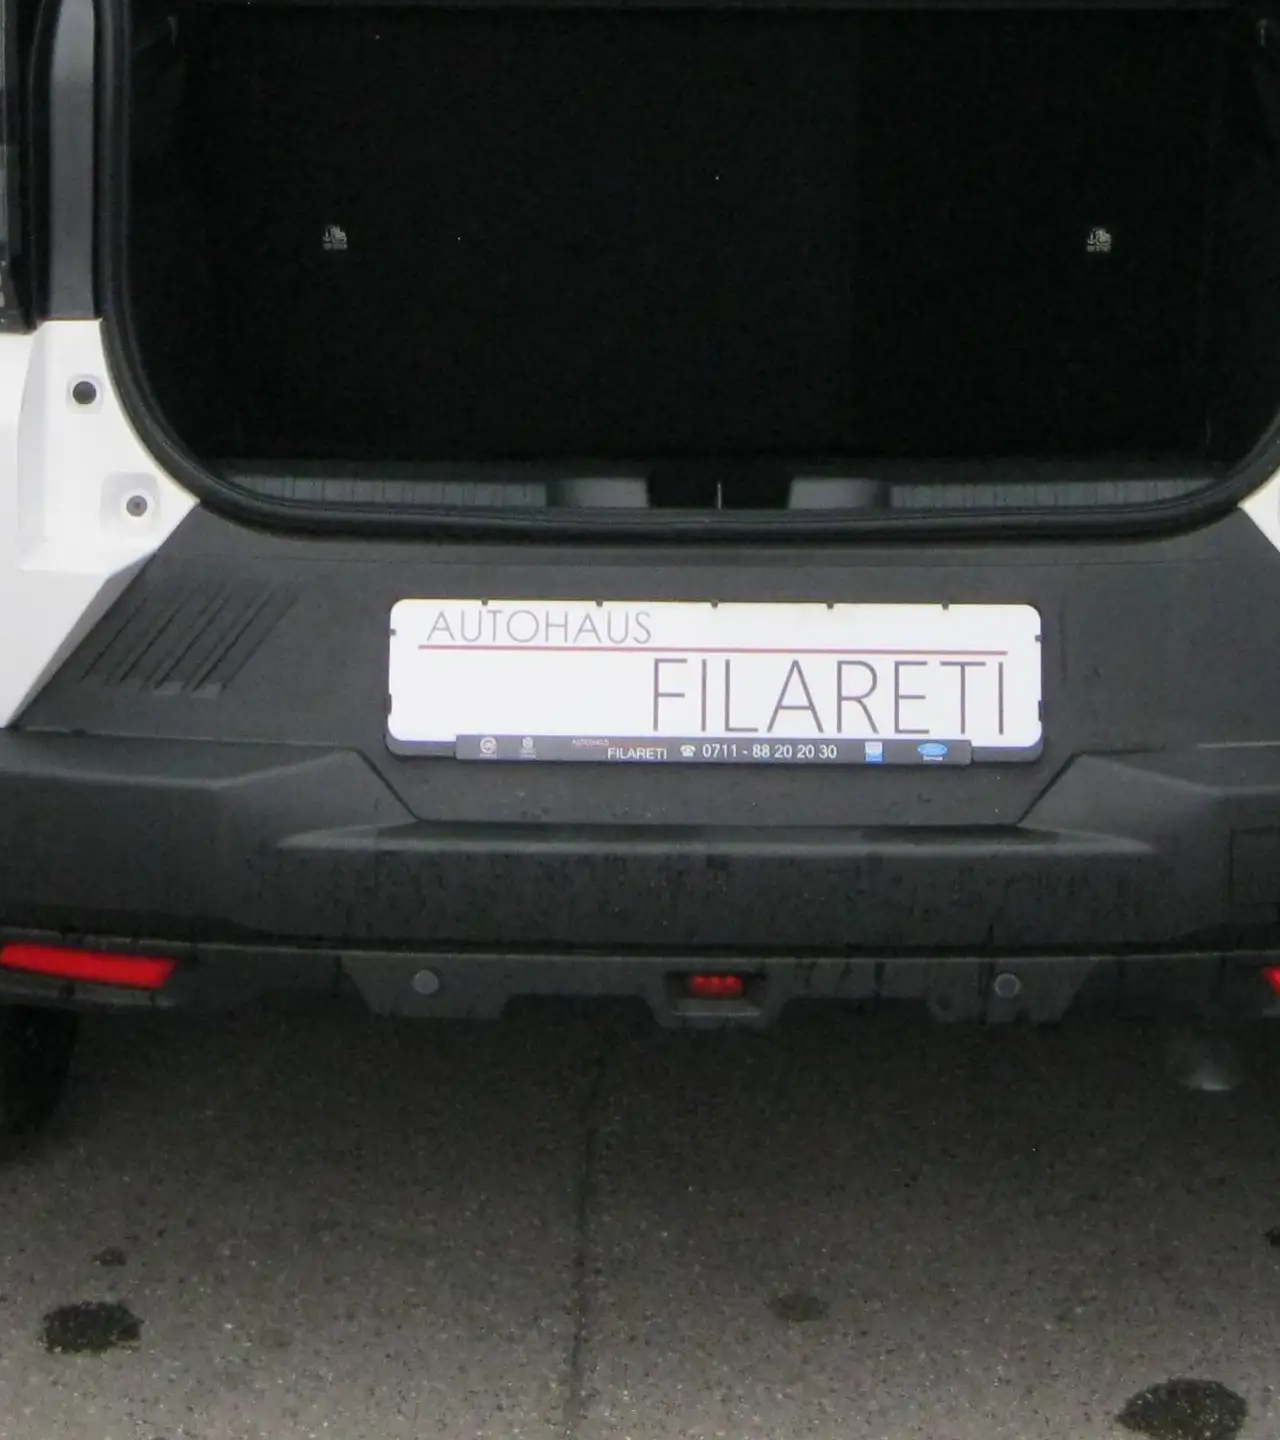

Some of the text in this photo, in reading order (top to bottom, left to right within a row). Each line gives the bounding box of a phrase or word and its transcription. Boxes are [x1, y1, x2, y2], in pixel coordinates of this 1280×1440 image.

[426, 610, 652, 644] AUTOHAUS
[652, 657, 1006, 735] FILARETI
[607, 747, 668, 760] FILARETI
[702, 743, 738, 758] 0711
[752, 744, 770, 758] 88
[774, 744, 793, 758] 20
[797, 744, 816, 758] 20
[818, 744, 838, 759] 30
